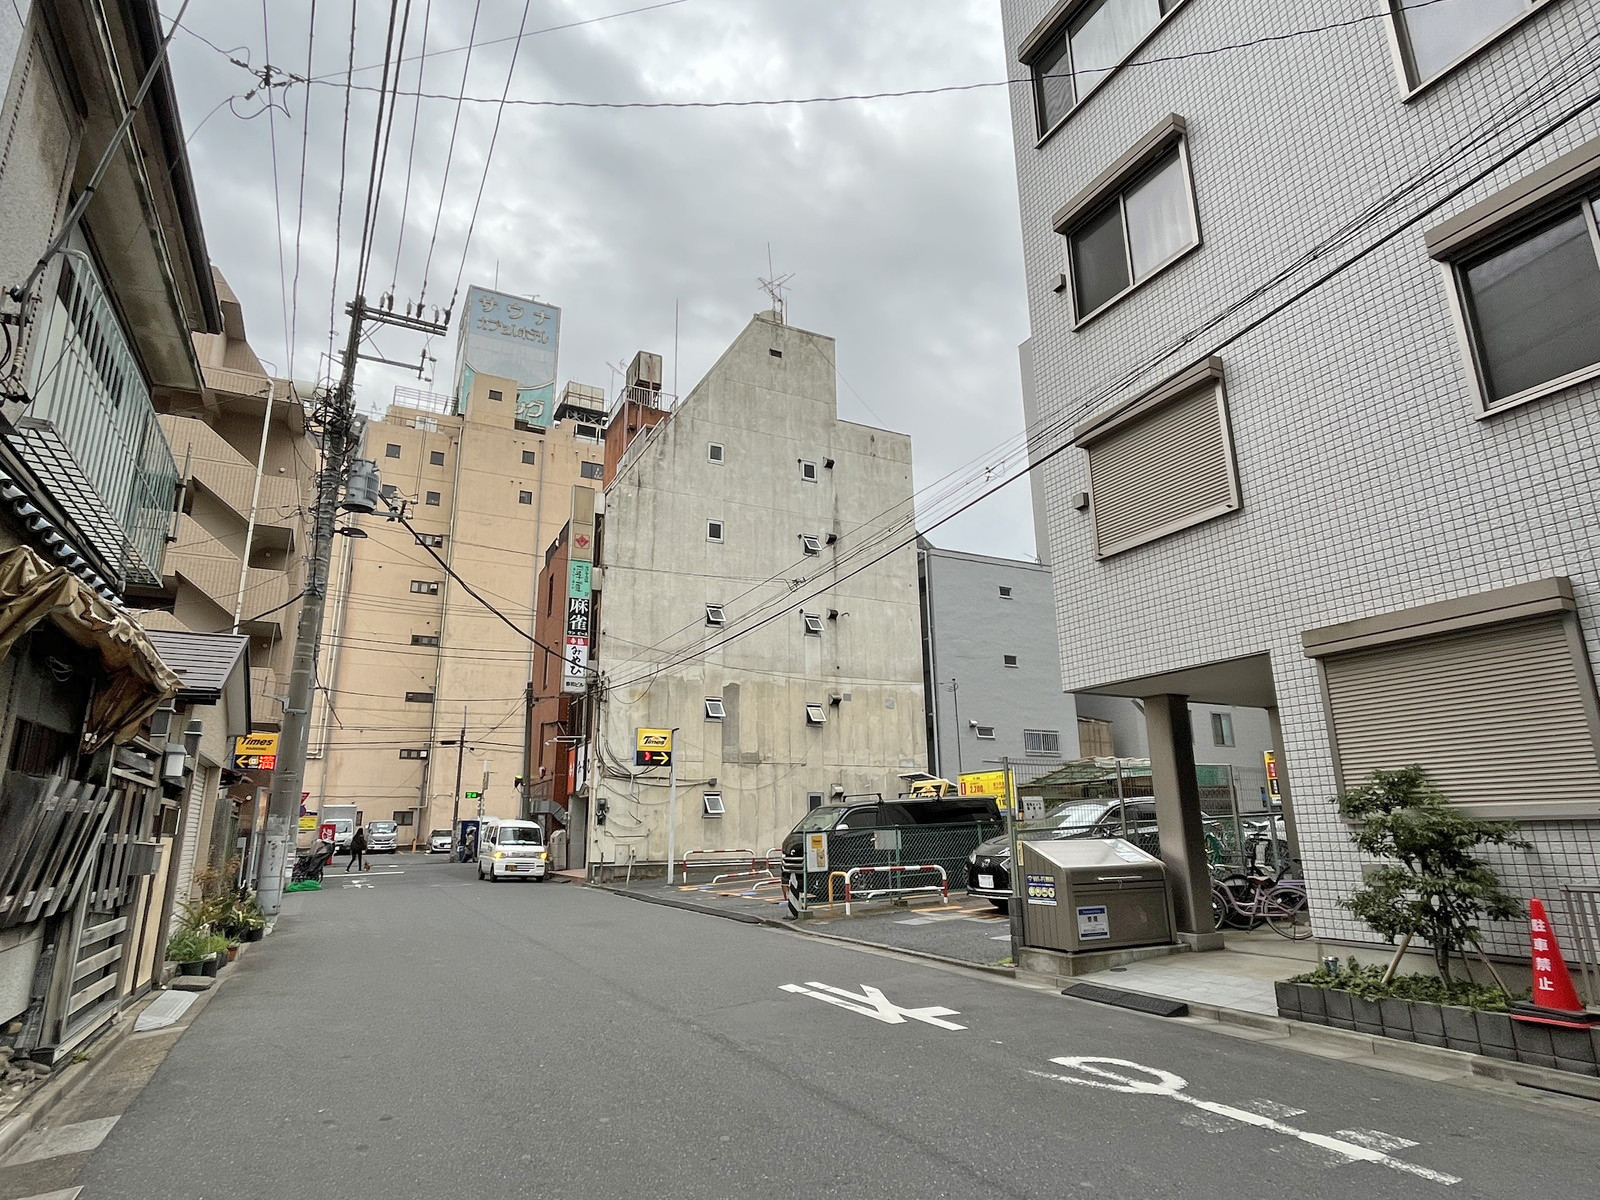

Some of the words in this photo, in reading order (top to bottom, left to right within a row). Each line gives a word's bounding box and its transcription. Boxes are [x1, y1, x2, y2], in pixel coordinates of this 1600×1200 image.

[478, 295, 551, 326] サウナ
[569, 598, 588, 630] 麻雀
[240, 736, 274, 746] Times
[1530, 918, 1555, 992] 駐車禁止
